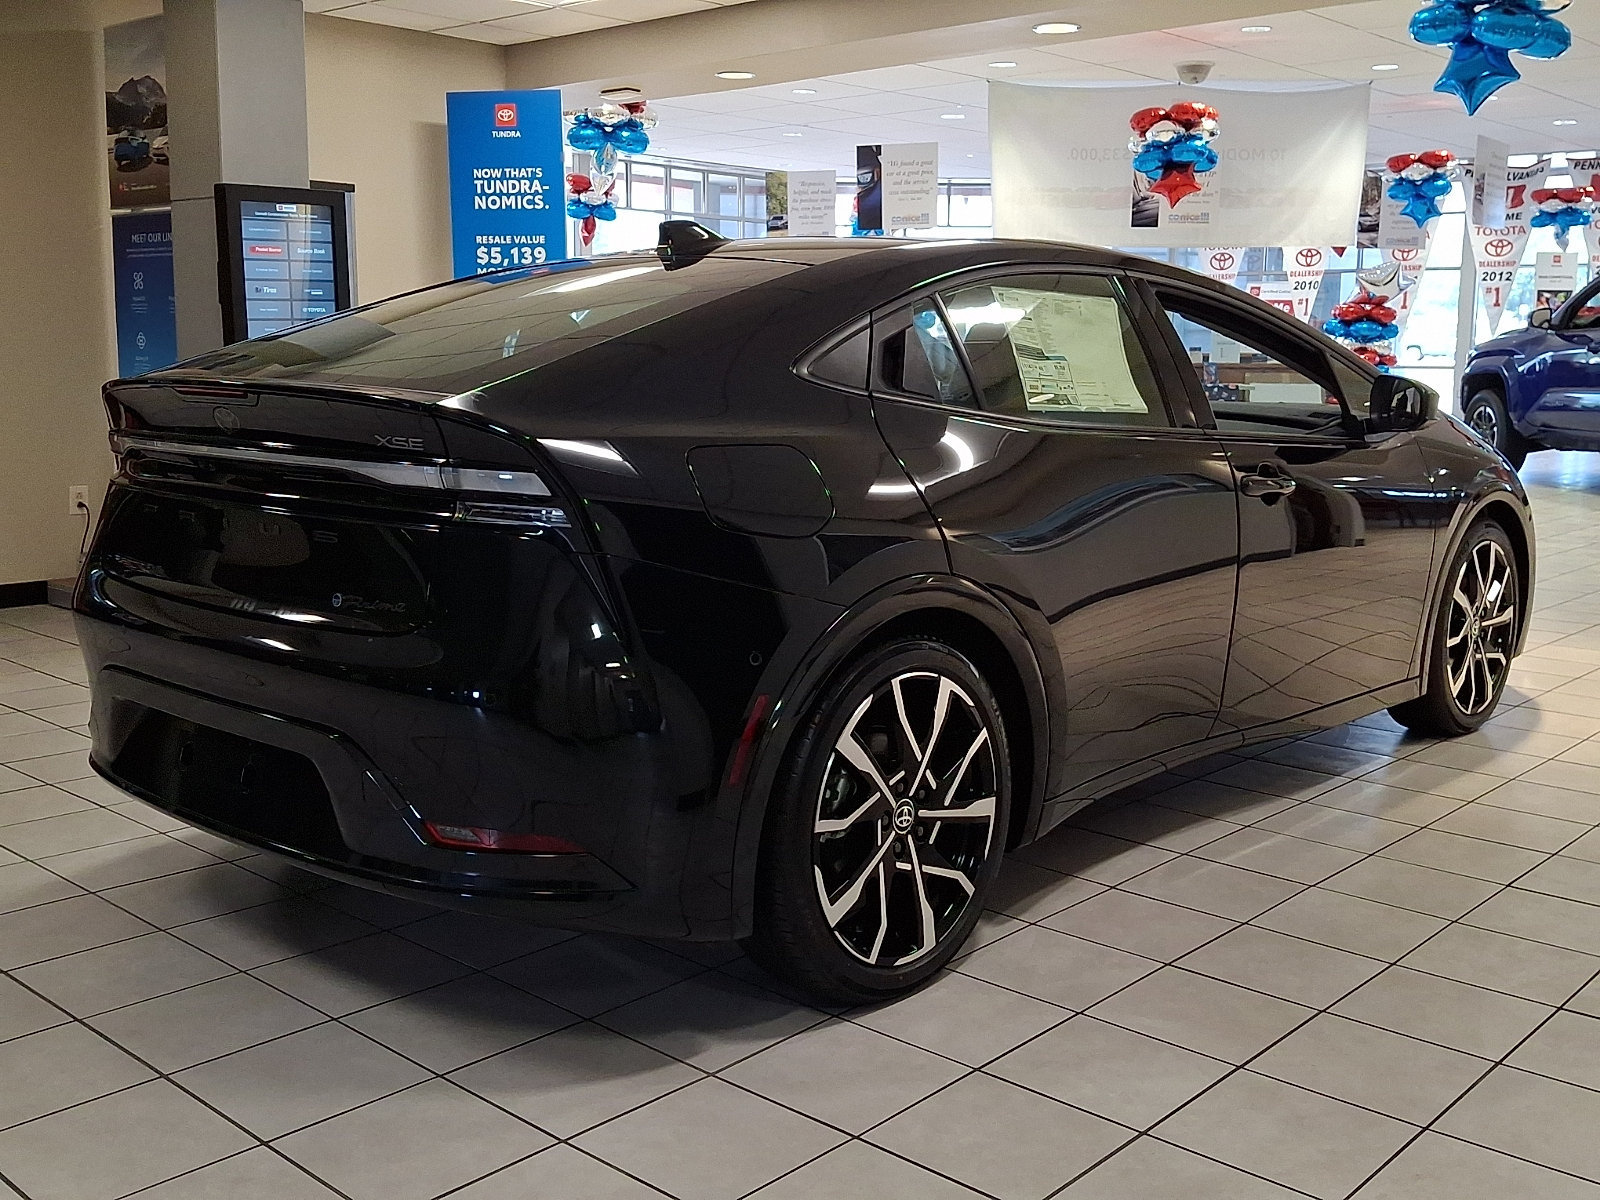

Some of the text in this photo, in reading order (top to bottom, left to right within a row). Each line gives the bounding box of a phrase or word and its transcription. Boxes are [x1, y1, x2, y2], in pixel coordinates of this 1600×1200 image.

[473, 167, 543, 178] NOW THAT'S
[474, 179, 549, 194] TUNDRA-
[474, 195, 549, 210] NOMICS.
[1475, 225, 1527, 236] TOYOTA
[131, 233, 147, 243] MEET
[148, 232, 162, 242] OUR
[476, 235, 546, 244] RESALE VALUE
[477, 246, 547, 267] $5,139
[1479, 260, 1517, 268] DEALERSHIP
[1290, 270, 1324, 278] DEALERSHIP
[1481, 271, 1513, 281] 2012
[1293, 280, 1320, 291] 2010
[1486, 286, 1501, 307] #1
[1298, 297, 1310, 317] #1
[374, 434, 425, 451] XSE
